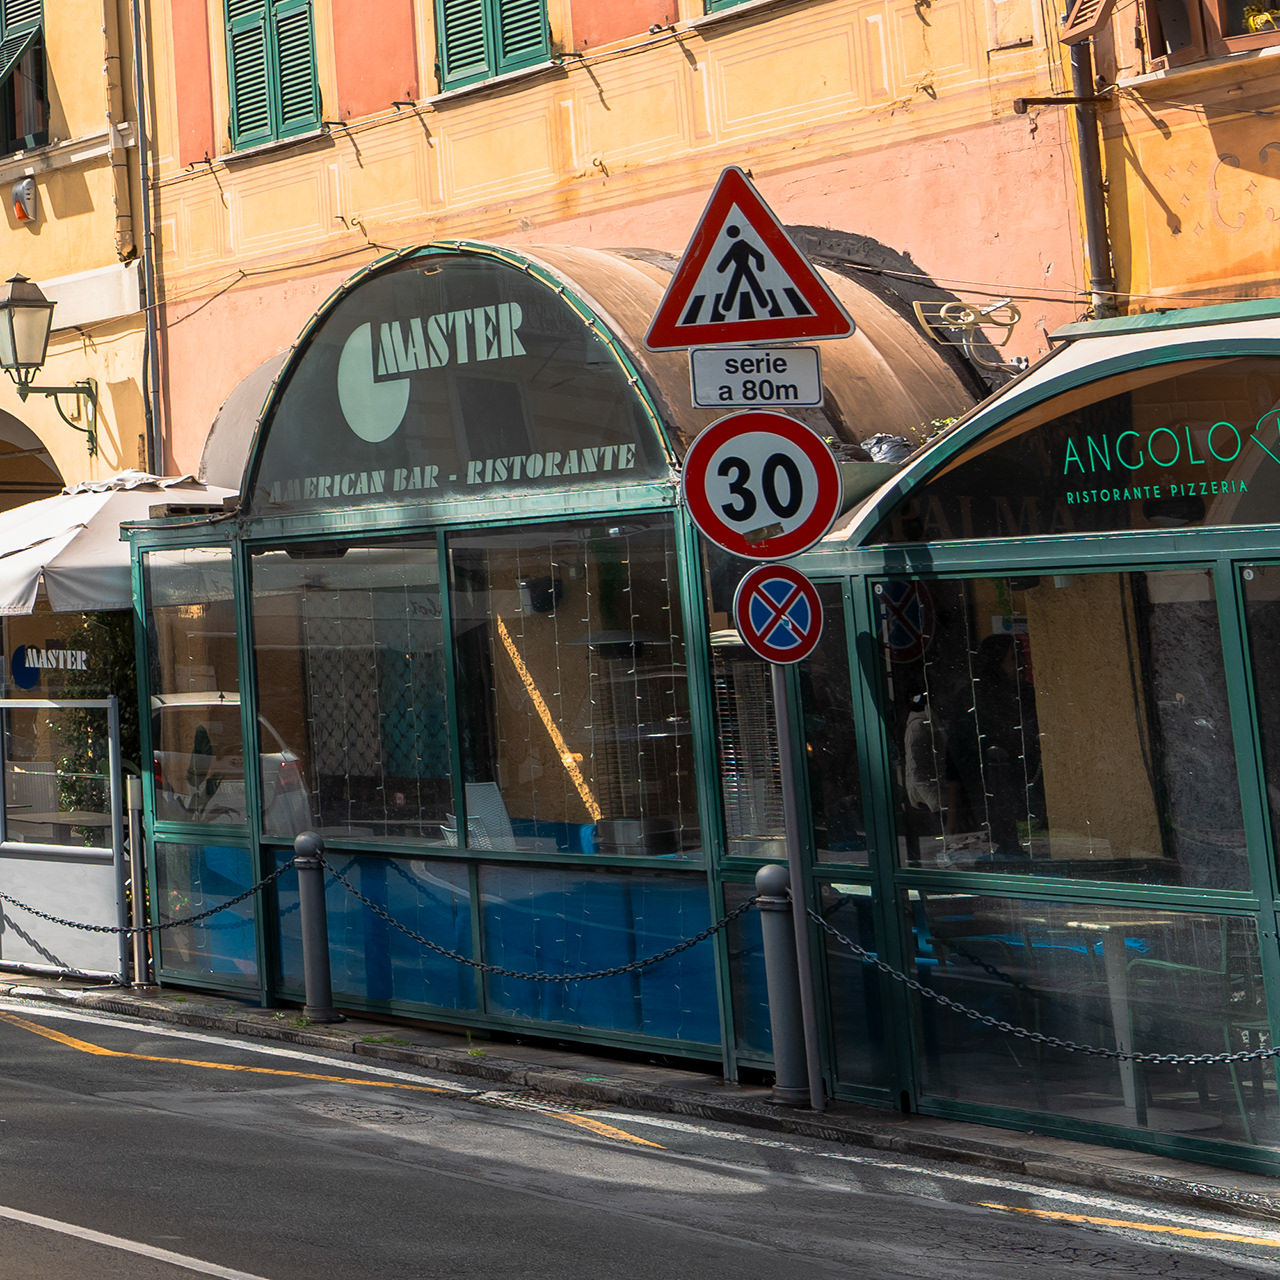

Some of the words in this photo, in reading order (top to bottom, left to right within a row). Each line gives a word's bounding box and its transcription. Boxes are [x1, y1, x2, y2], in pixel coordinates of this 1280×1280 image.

[376, 301, 528, 376] MASTER
[724, 353, 788, 375] serie
[718, 386, 734, 402] a
[742, 380, 799, 402] 80m
[1064, 421, 1241, 475] ANGOLO
[269, 469, 386, 503] AMERICAN
[392, 464, 438, 492] BAR
[466, 443, 637, 485] RISTORANTE
[716, 452, 805, 522] 30
[1066, 485, 1161, 504] RISTORANTE
[1170, 480, 1249, 497] PIZZERIA
[24, 647, 88, 671] MASTER
